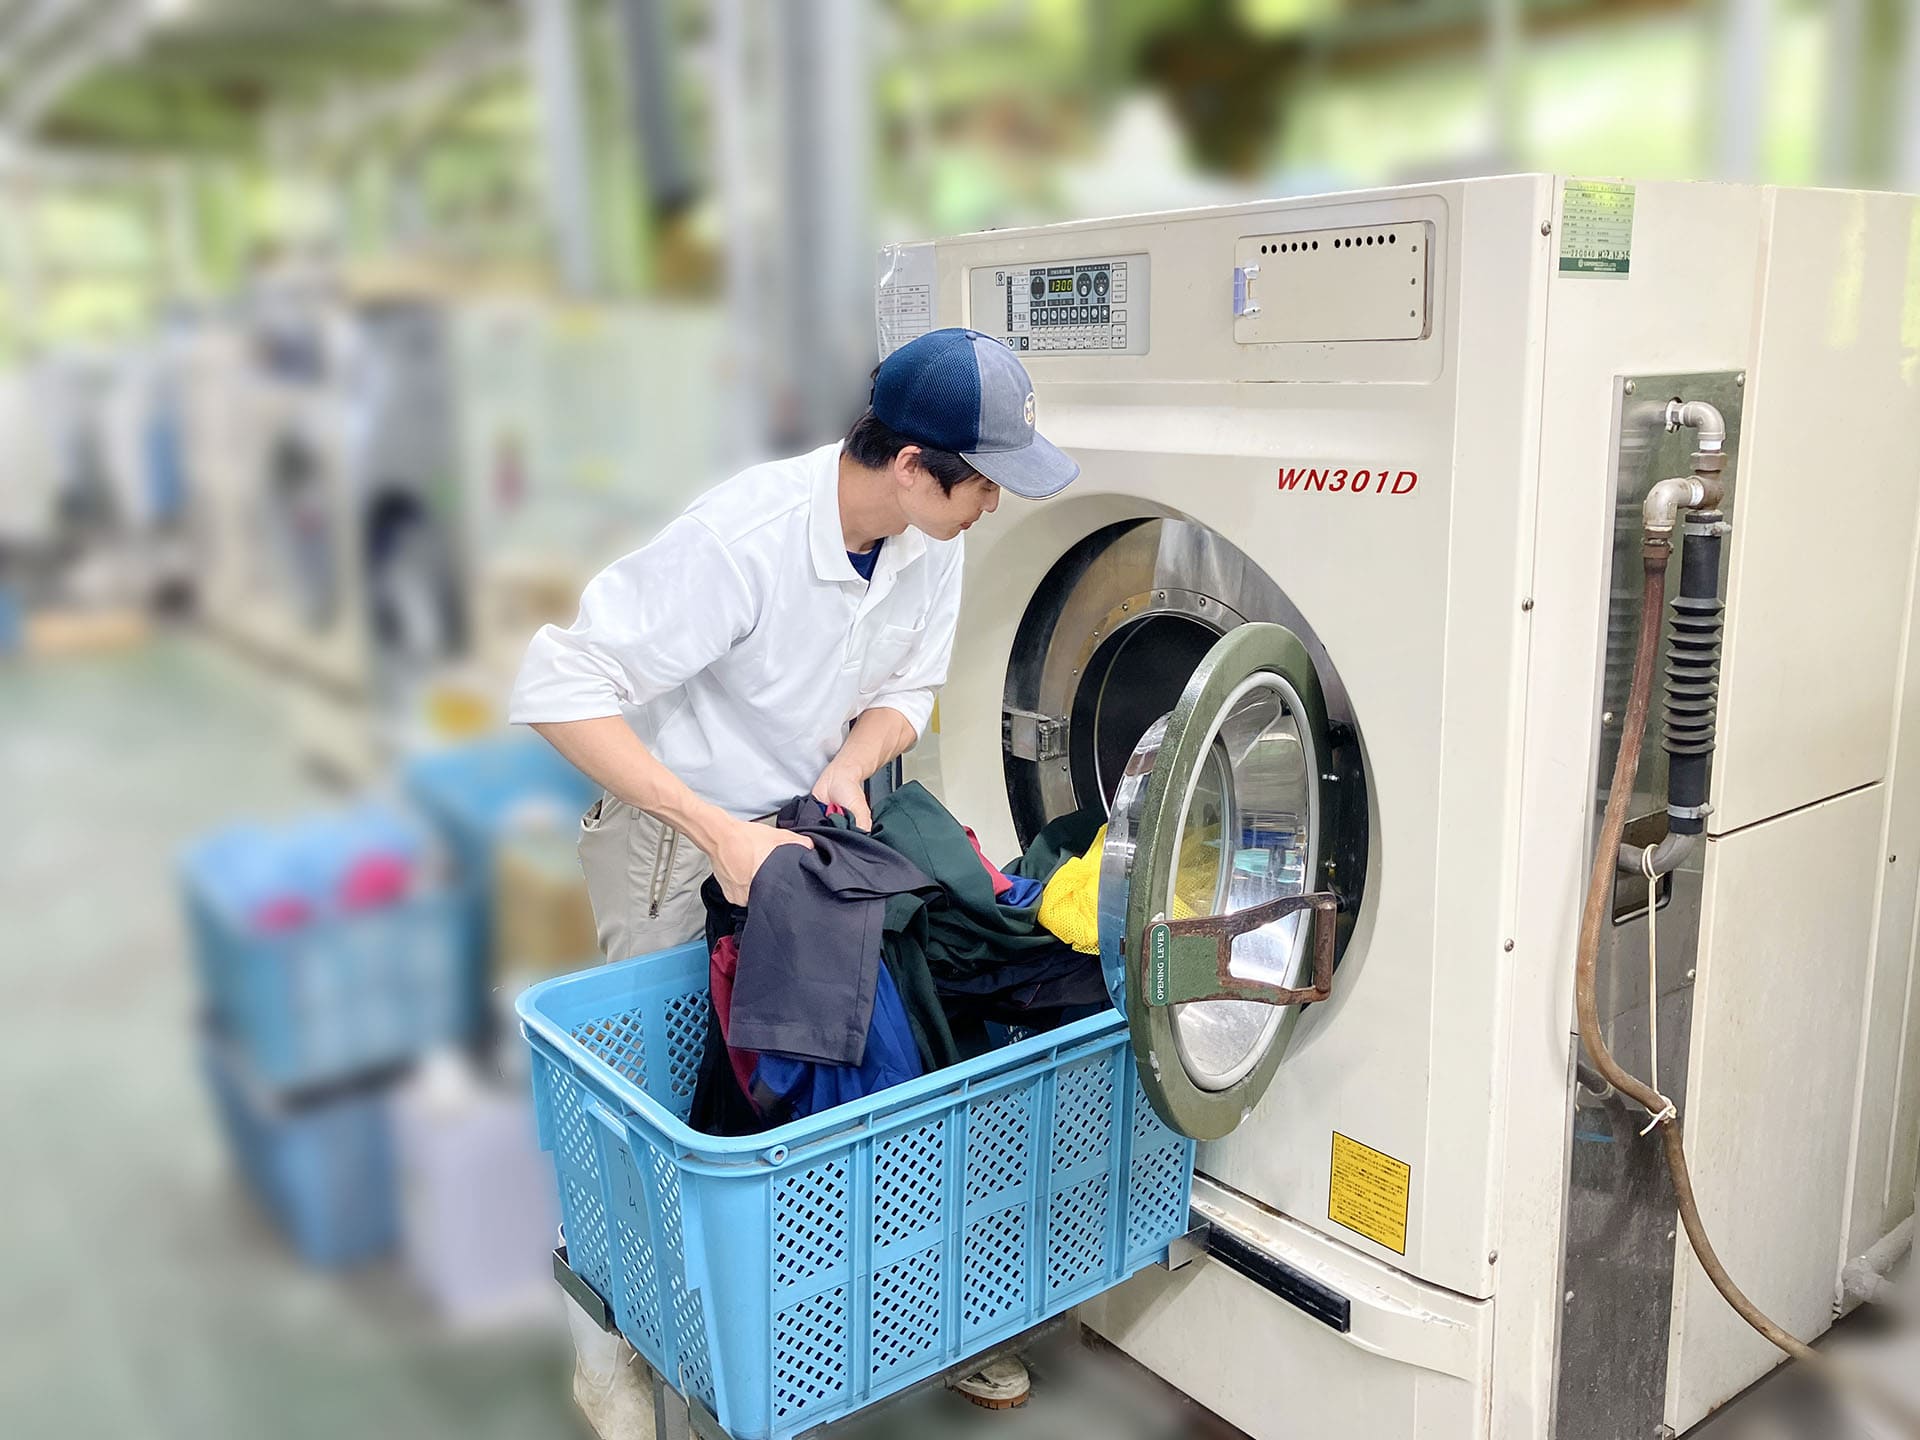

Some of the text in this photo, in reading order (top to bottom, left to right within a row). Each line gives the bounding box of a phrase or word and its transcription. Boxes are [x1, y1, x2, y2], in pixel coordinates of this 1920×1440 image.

[1051, 279, 1073, 291] 1300
[1278, 467, 1418, 494] WN301D
[1157, 930, 1165, 1000] OPENING LEVER
